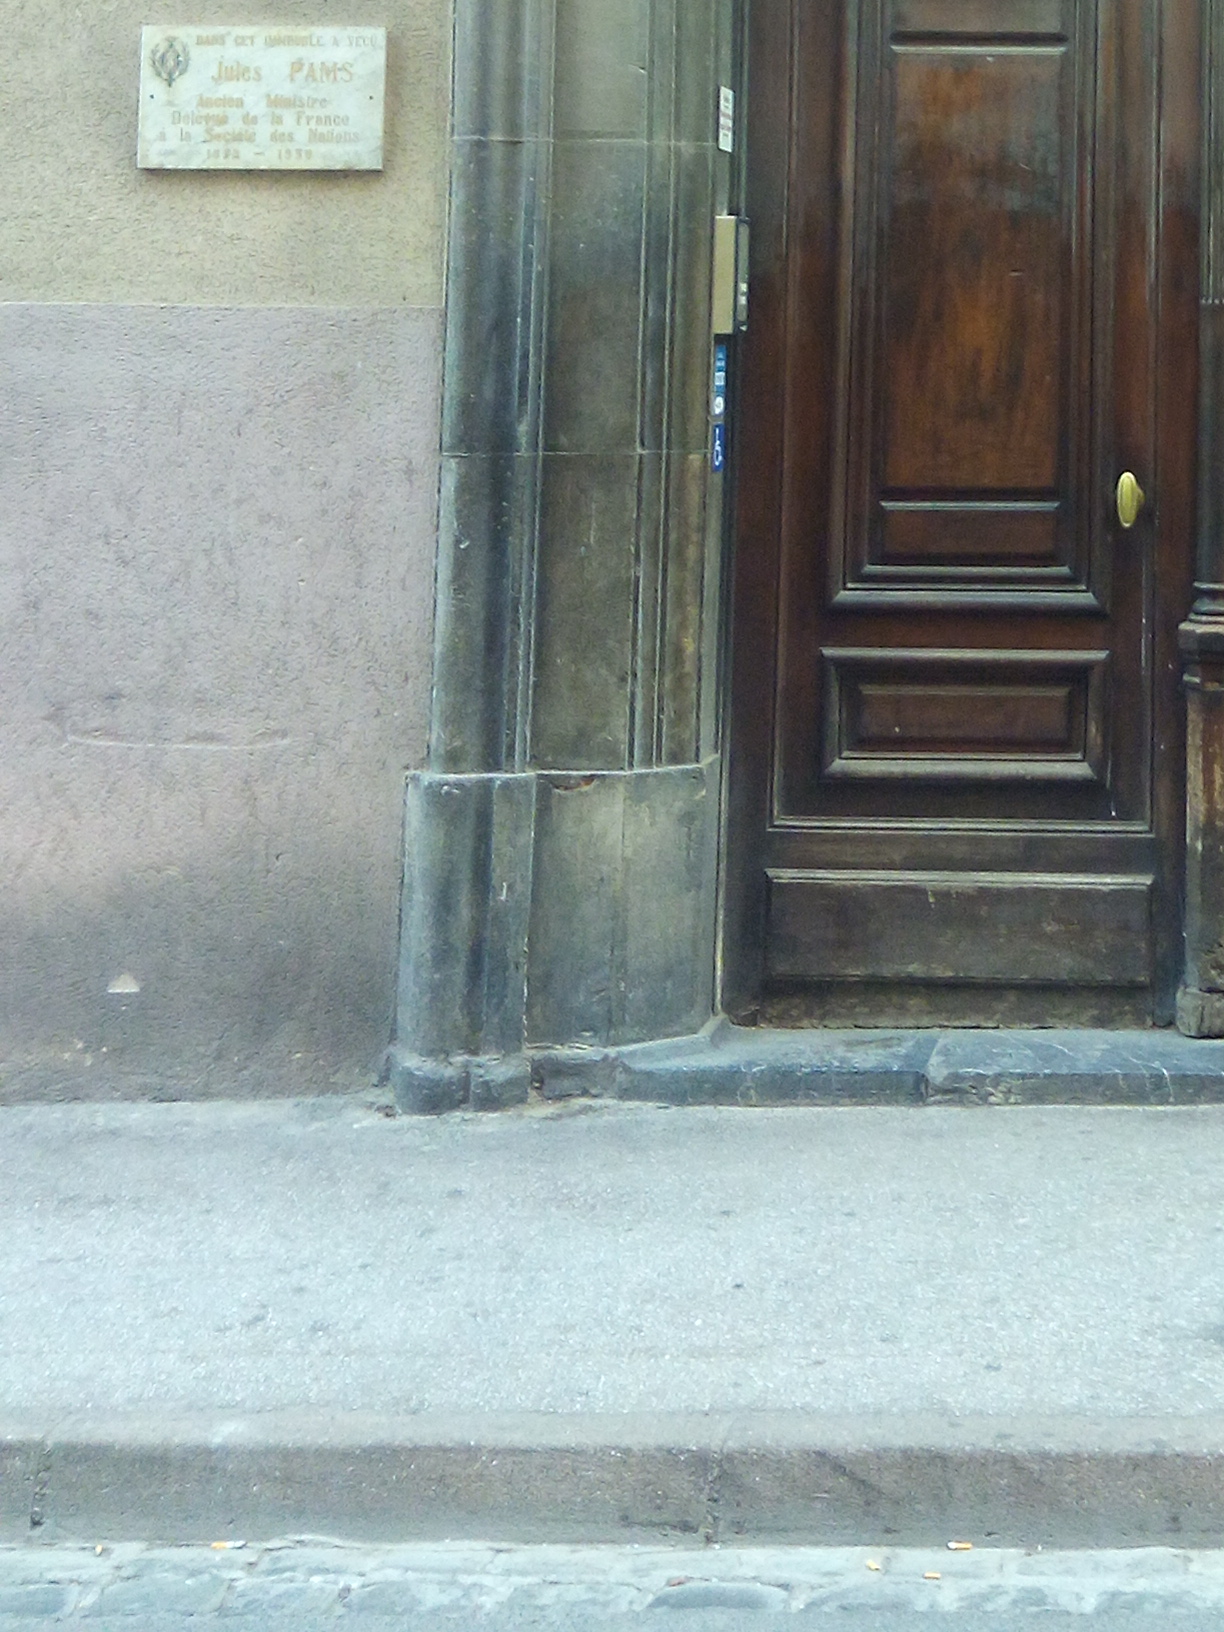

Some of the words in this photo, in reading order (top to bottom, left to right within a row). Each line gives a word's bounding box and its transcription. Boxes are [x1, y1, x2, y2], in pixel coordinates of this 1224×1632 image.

[234, 34, 256, 47] CET
[331, 35, 340, 47] A
[211, 55, 263, 83] Jules
[288, 59, 355, 83] PAMS
[196, 94, 244, 109] Ancien
[265, 94, 329, 109] Ministre
[242, 111, 259, 126] de
[271, 111, 284, 126] la
[296, 111, 351, 126] France
[180, 127, 192, 142] la
[270, 129, 295, 143] des
[308, 128, 361, 143] Nations
